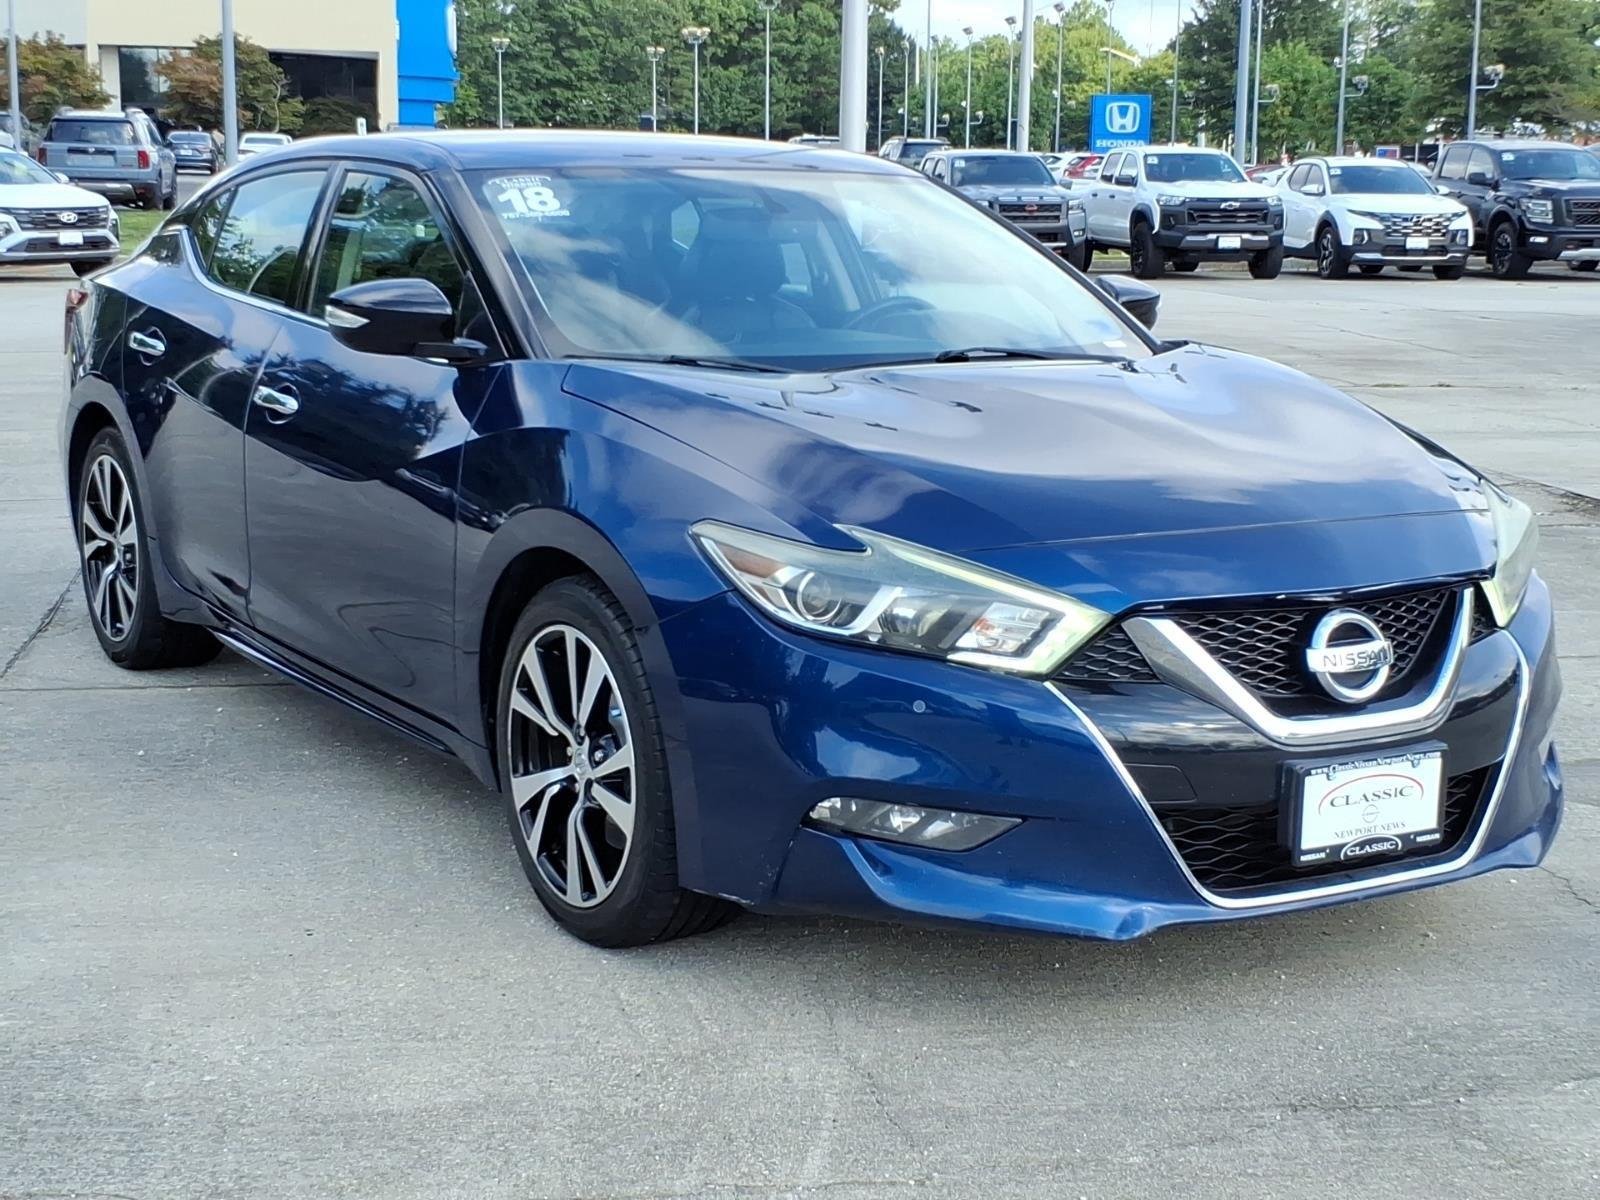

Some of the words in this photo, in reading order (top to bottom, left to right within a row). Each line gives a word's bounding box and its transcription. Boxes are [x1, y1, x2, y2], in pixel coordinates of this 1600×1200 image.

[1096, 139, 1144, 148] HONDA
[497, 187, 561, 215] 18
[1323, 645, 1389, 668] NISSAN
[1330, 785, 1414, 808] CLASSIC
[1334, 824, 1378, 839] NEWPORT
[1380, 820, 1406, 831] NEWS
[1346, 840, 1397, 856] CLASSIC
